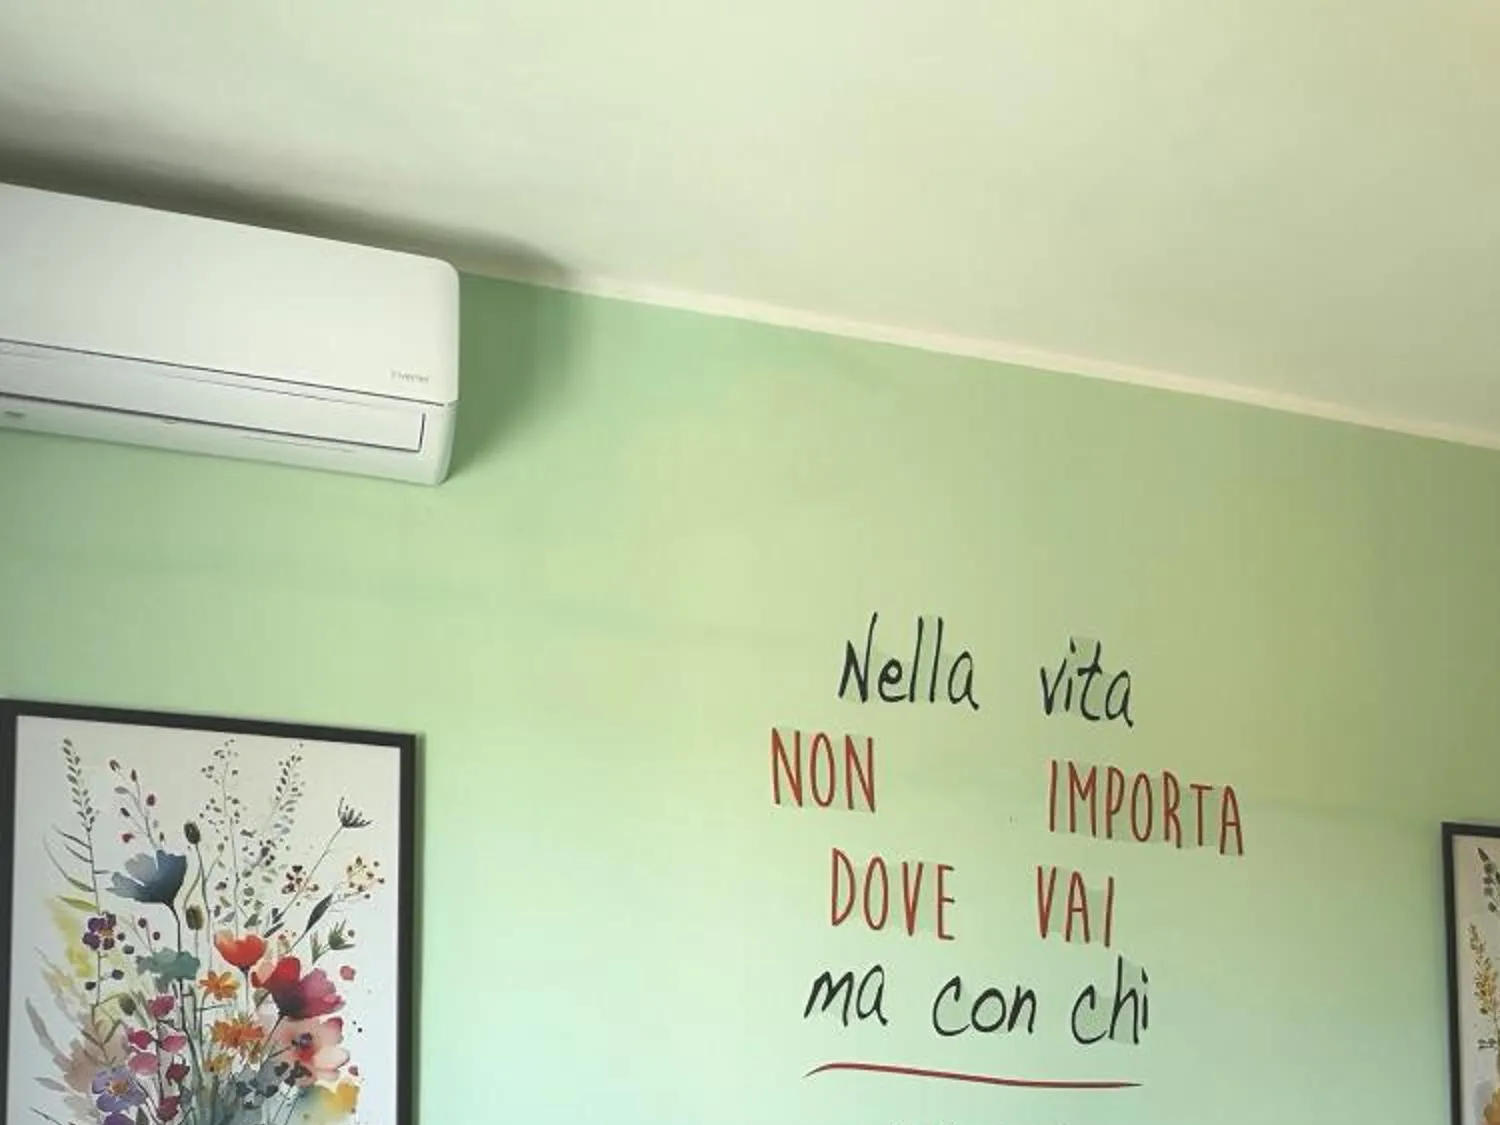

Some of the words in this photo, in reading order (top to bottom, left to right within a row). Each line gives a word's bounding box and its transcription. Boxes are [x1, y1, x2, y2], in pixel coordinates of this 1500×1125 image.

[837, 611, 980, 711] Nella
[1039, 638, 1134, 729] vita
[771, 727, 876, 813] NON
[1049, 760, 1244, 856] IMPORTA
[831, 847, 956, 941] DOVE
[1037, 865, 1115, 949] VAI
[803, 964, 889, 1028] ma
[932, 975, 1037, 1037] con
[1071, 955, 1149, 1046] chi
